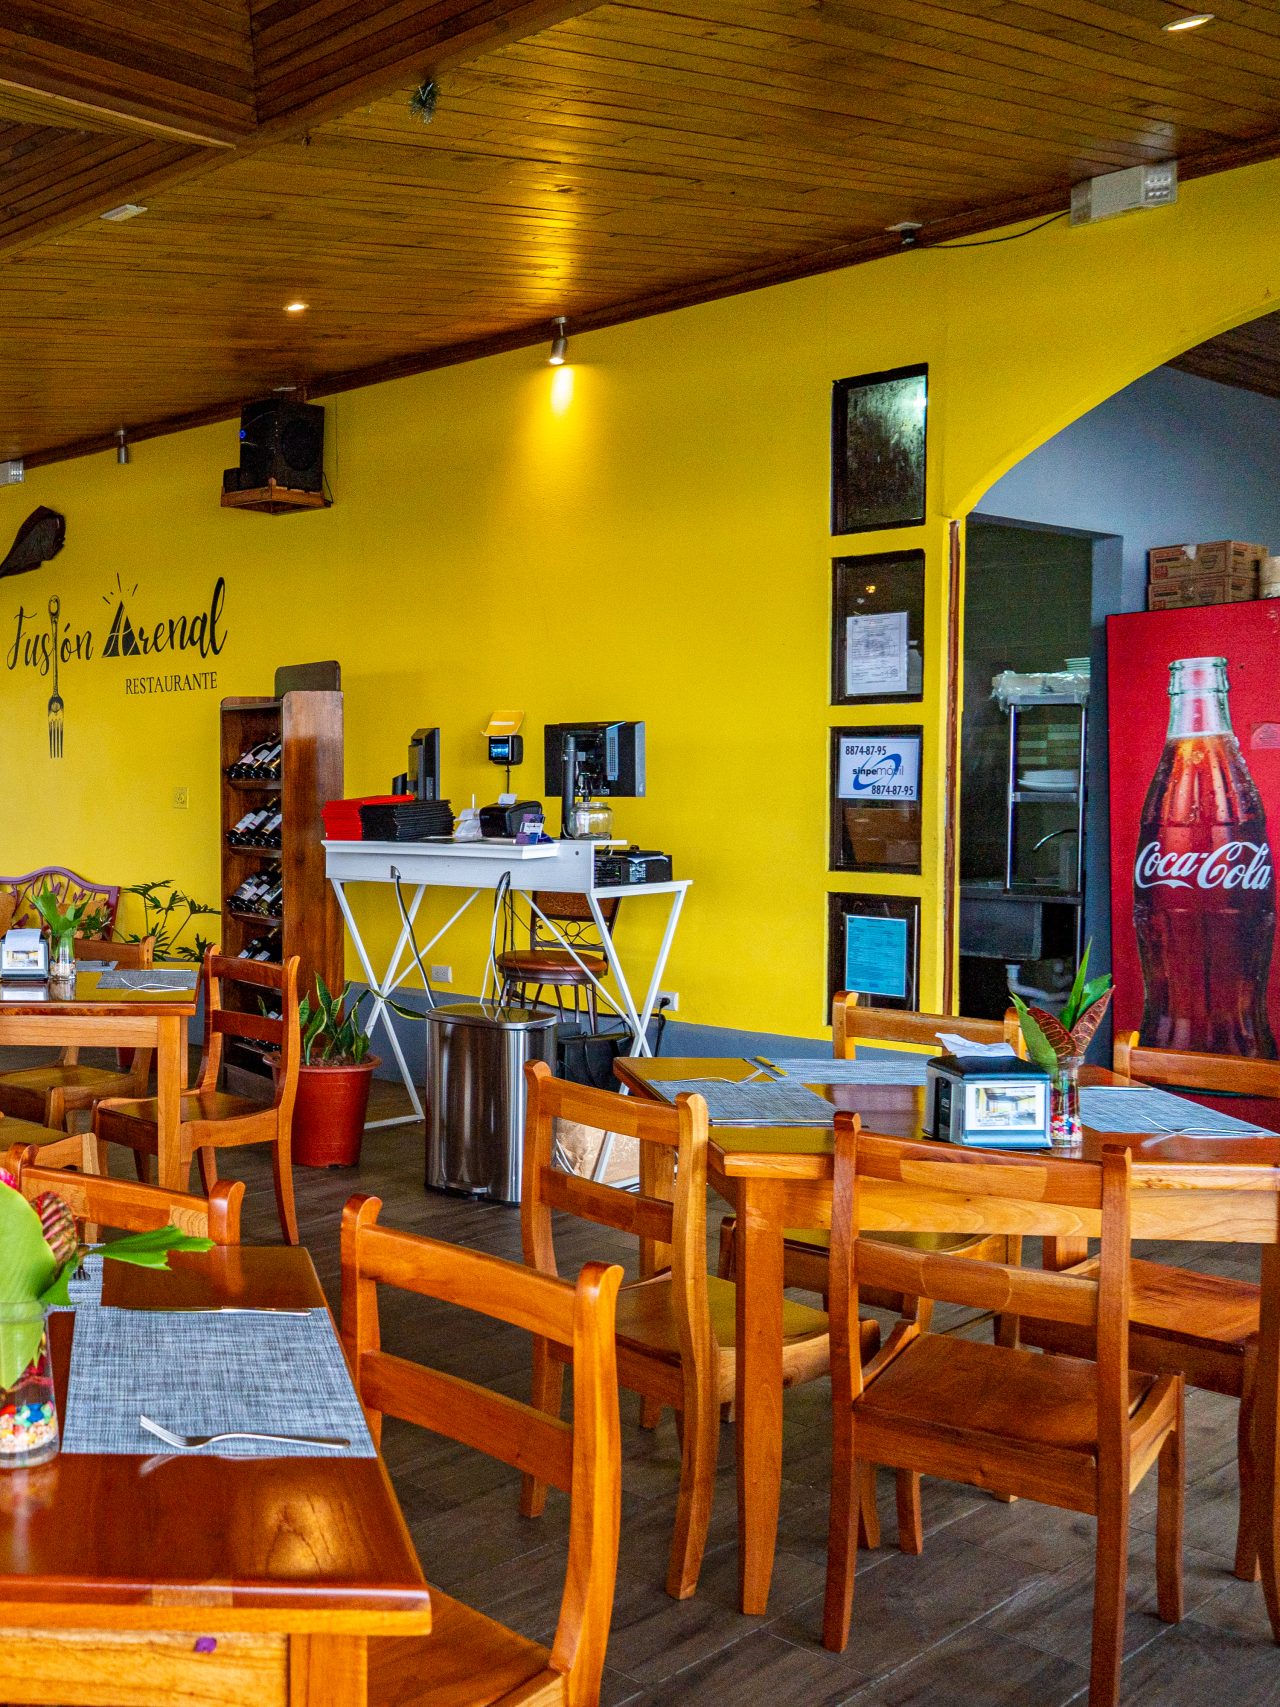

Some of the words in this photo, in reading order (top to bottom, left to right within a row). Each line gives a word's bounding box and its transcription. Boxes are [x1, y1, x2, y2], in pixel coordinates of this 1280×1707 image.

[102, 577, 228, 659] Arenal
[125, 671, 218, 695] RESTAURANTE
[845, 745, 887, 756] 8874-87-95
[871, 785, 914, 796] 8874-87-95
[1135, 841, 1271, 889] Coca-Cola
